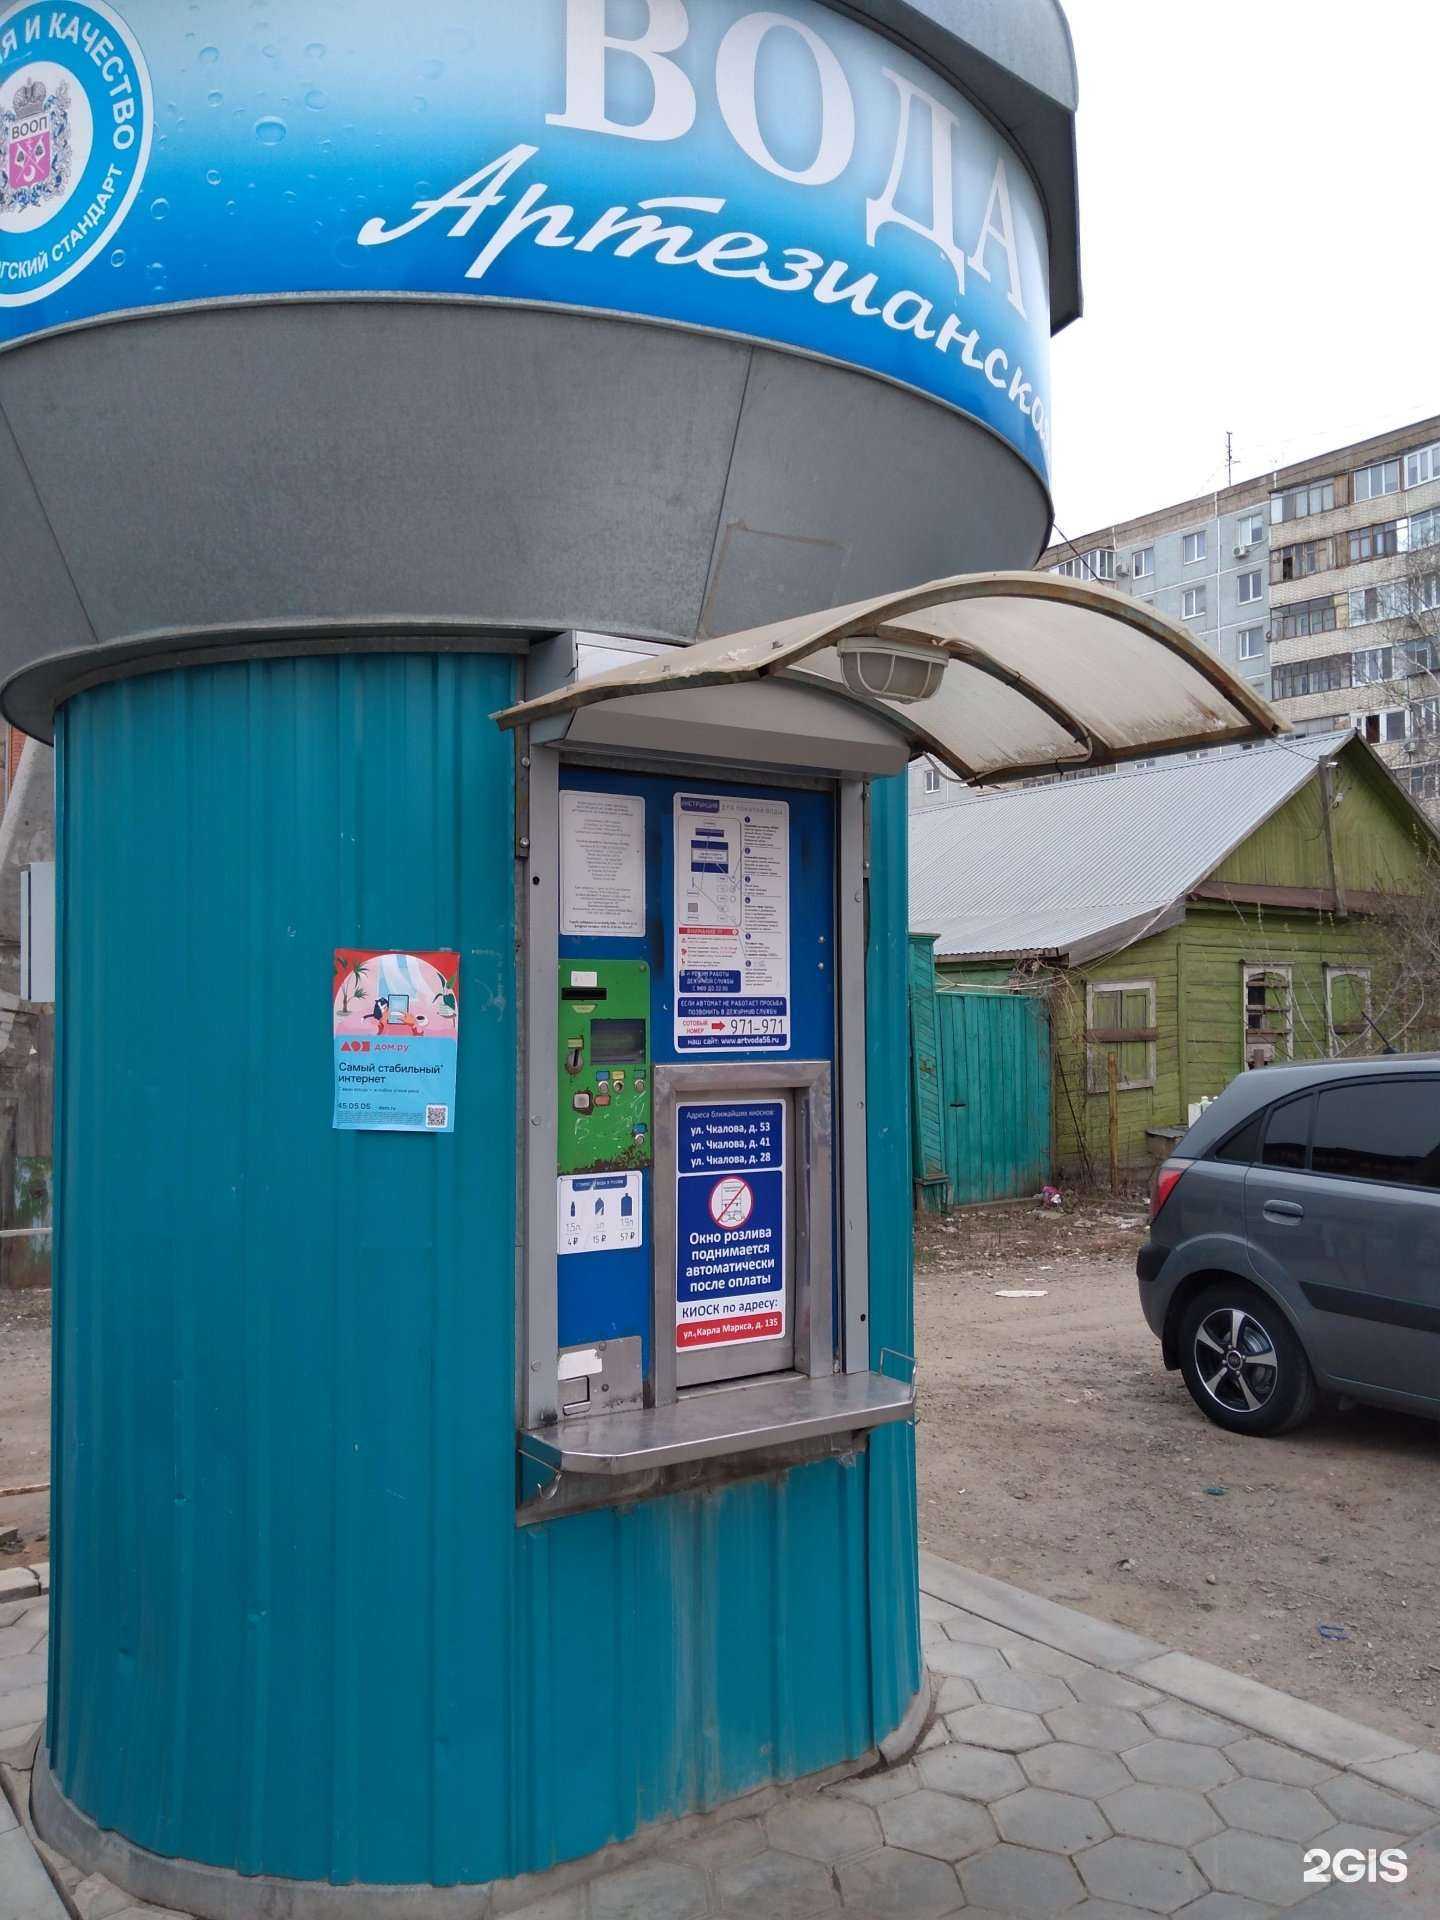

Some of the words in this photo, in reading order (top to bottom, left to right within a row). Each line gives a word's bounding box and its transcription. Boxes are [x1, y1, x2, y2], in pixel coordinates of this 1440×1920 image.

[0, 27, 18, 64] Я
[25, 14, 41, 44] И
[48, 12, 135, 151] КАЧЕСТВО
[12, 116, 48, 140] ВООП
[545, 0, 1028, 321] ВОДА
[0, 250, 49, 280] ГСКИЙ
[51, 162, 122, 262] СТАНДАРТ
[730, 1018, 784, 1035] 971-971
[721, 1035, 780, 1045] www.artvoda56.ru
[338, 1062, 376, 1073] Самый
[338, 1074, 386, 1086] интернет
[686, 1111, 710, 1120] Адреса
[690, 1127, 704, 1137] ул.
[706, 1124, 747, 1134] Чкалова,
[748, 1124, 758, 1134] д.
[759, 1121, 771, 1132] 53
[690, 1142, 705, 1153] ул.
[706, 1140, 747, 1150] Чкалова,
[748, 1140, 759, 1149] д.
[759, 1137, 771, 1147] 41
[690, 1158, 705, 1168] ул.
[706, 1155, 747, 1165] Чкалова,
[748, 1155, 759, 1165] д.
[760, 1152, 771, 1162] 28
[689, 1232, 721, 1245] Окно
[724, 1228, 772, 1245] розлива
[691, 1244, 770, 1262] поднимается
[686, 1258, 775, 1278] автоматически
[690, 1279, 726, 1293] после
[728, 1274, 771, 1288] оплаты
[682, 1303, 720, 1319] КИОСК
[723, 1304, 736, 1313] по
[738, 1299, 779, 1313] адресу:
[696, 1327, 721, 1337] Карла
[722, 1322, 755, 1333] Маркса,
[765, 1318, 779, 1327] 135
